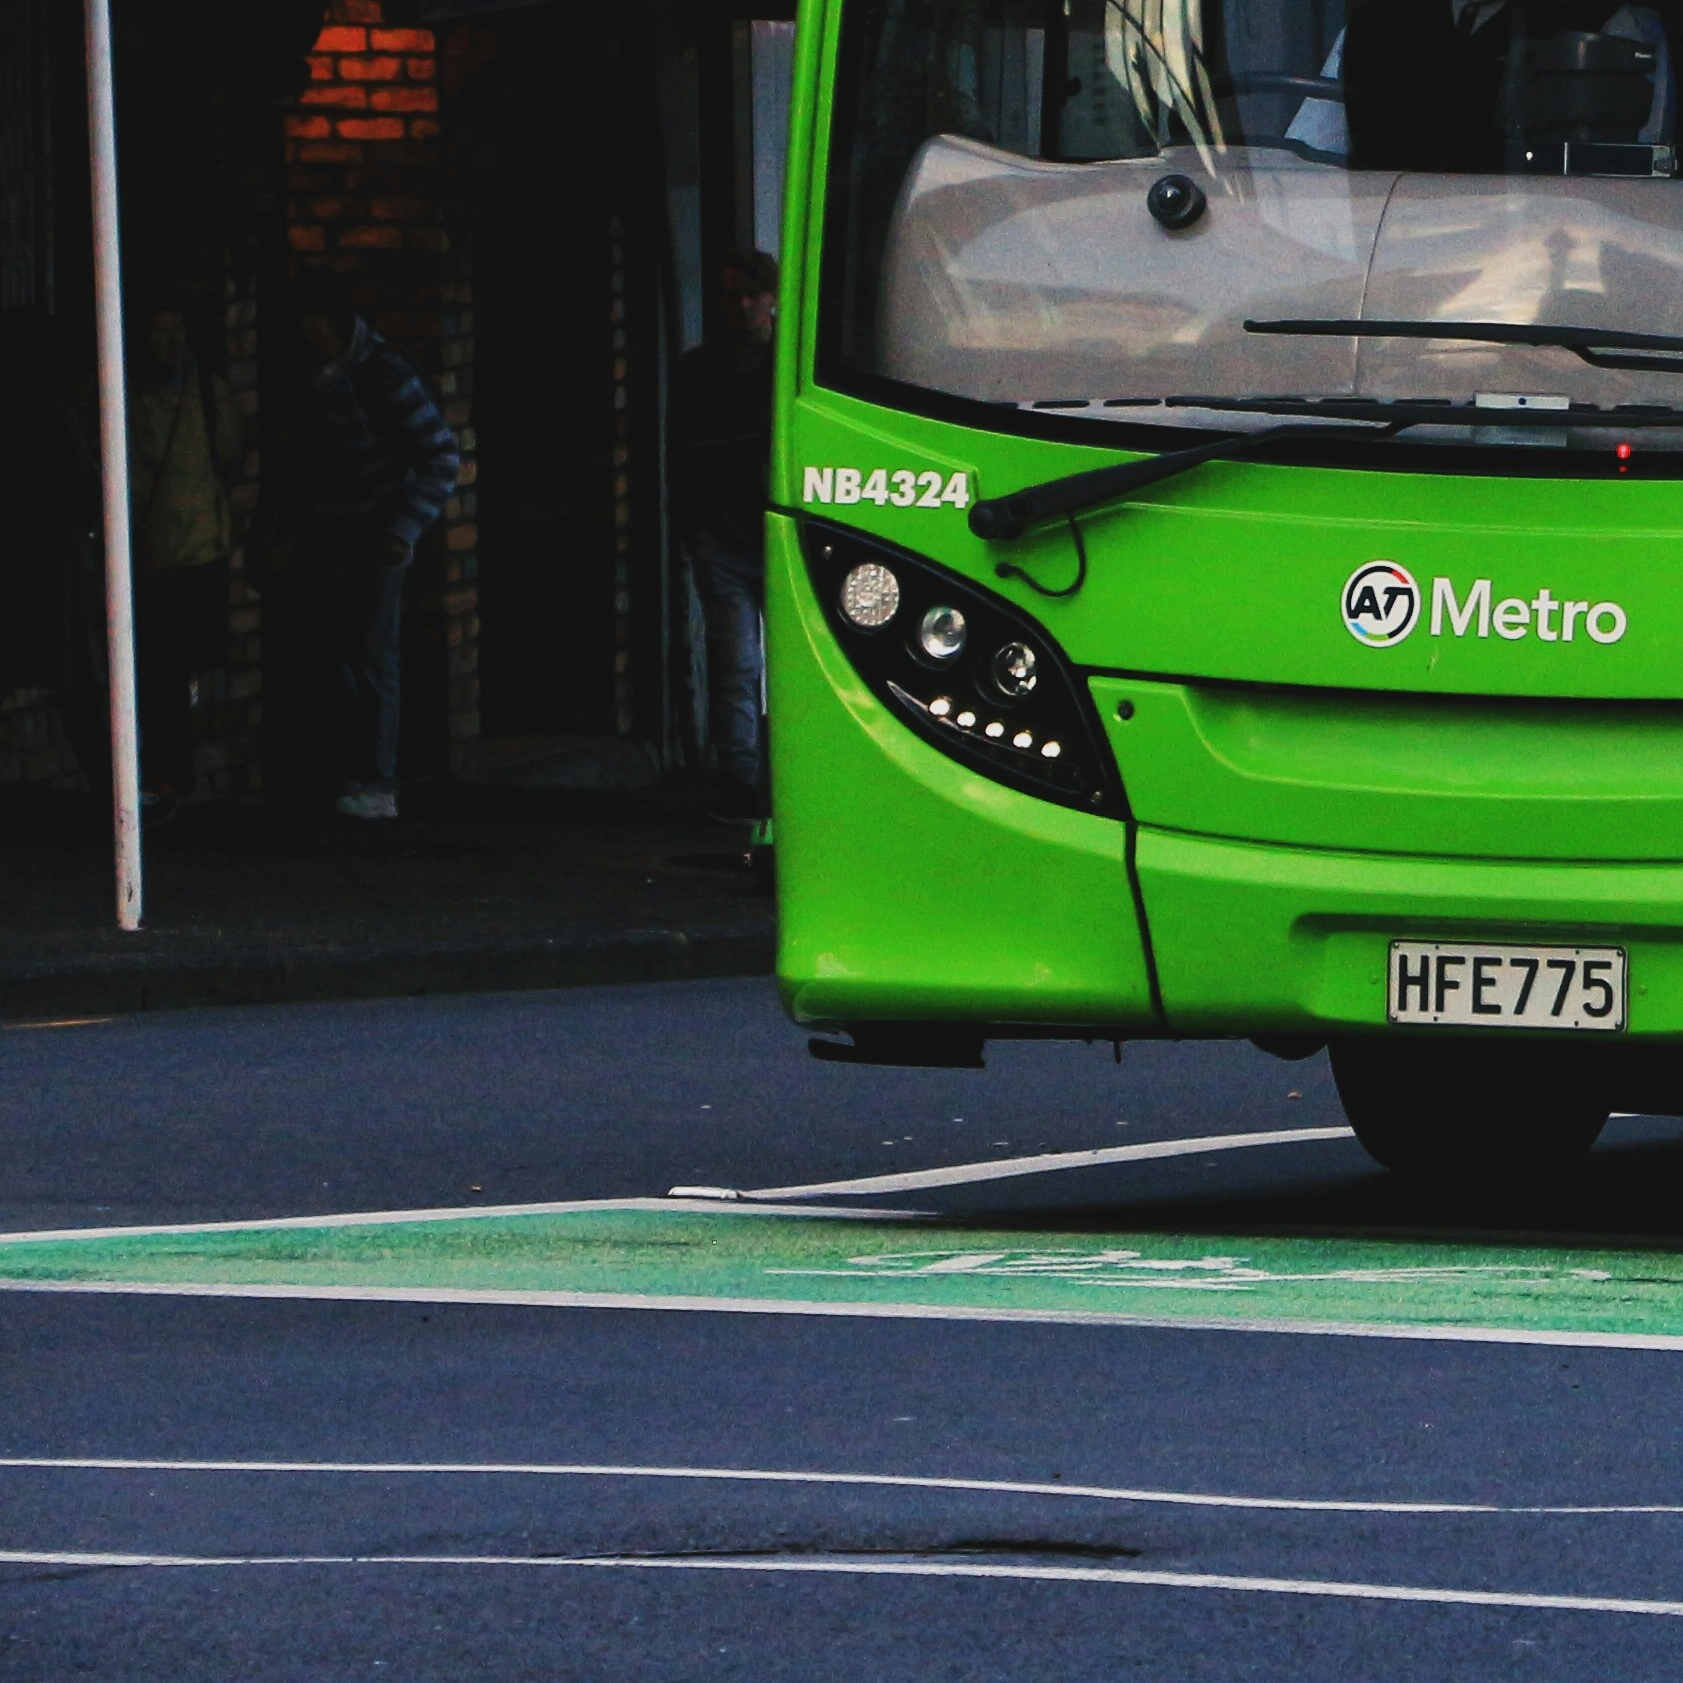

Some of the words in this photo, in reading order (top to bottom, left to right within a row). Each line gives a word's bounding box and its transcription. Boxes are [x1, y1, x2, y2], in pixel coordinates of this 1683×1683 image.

[802, 466, 970, 509] NB4324
[1430, 576, 1628, 646] Metro
[1397, 953, 1614, 1018] HFE775
